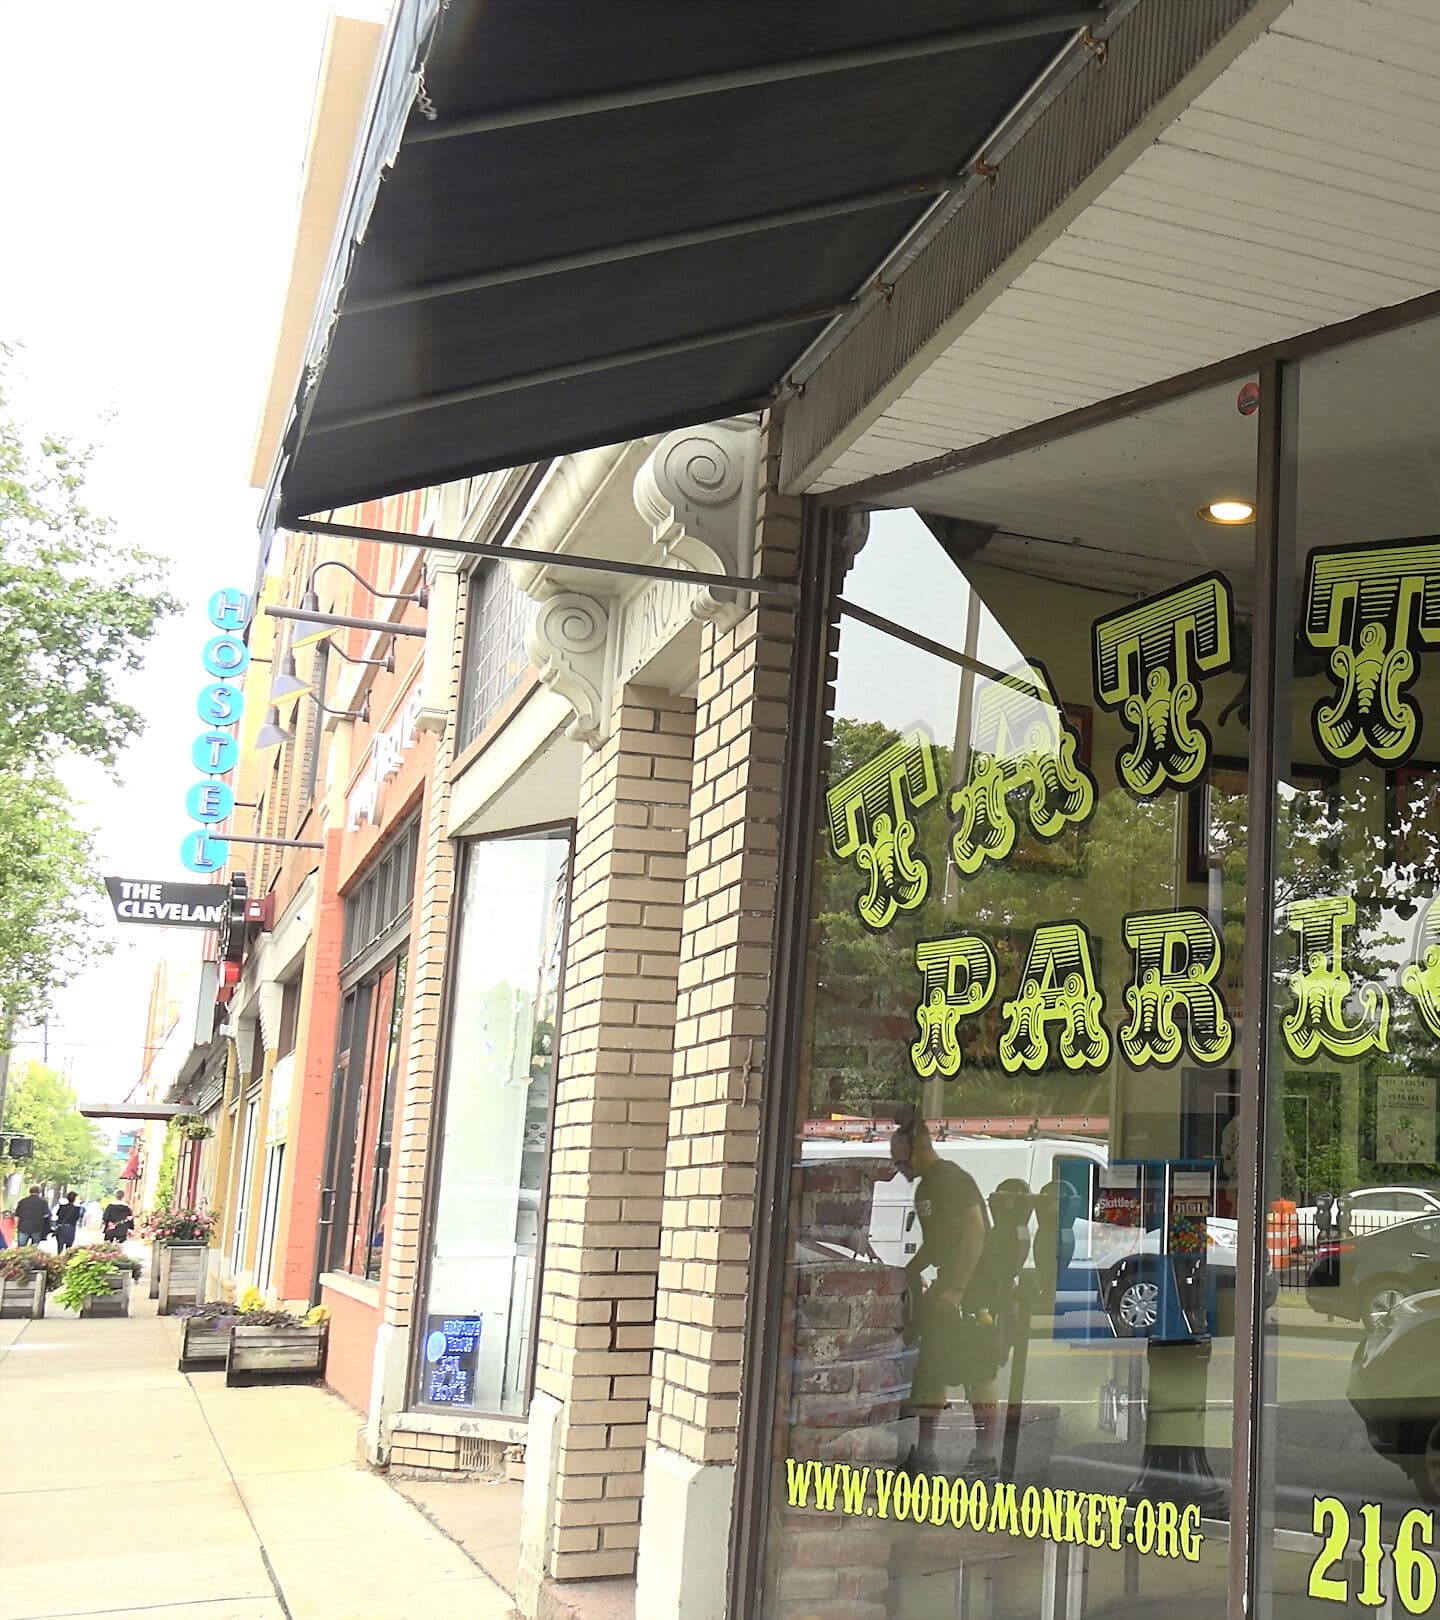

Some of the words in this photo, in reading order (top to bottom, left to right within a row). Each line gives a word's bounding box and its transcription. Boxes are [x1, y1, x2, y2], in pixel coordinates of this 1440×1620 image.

[193, 590, 249, 868] HOSTEL
[120, 881, 163, 901] THE
[117, 901, 223, 923] CLEVELAN
[1099, 1196, 1136, 1211] Skittles
[785, 1457, 1204, 1562] WWW.VOODOOMONKEY.ORG
